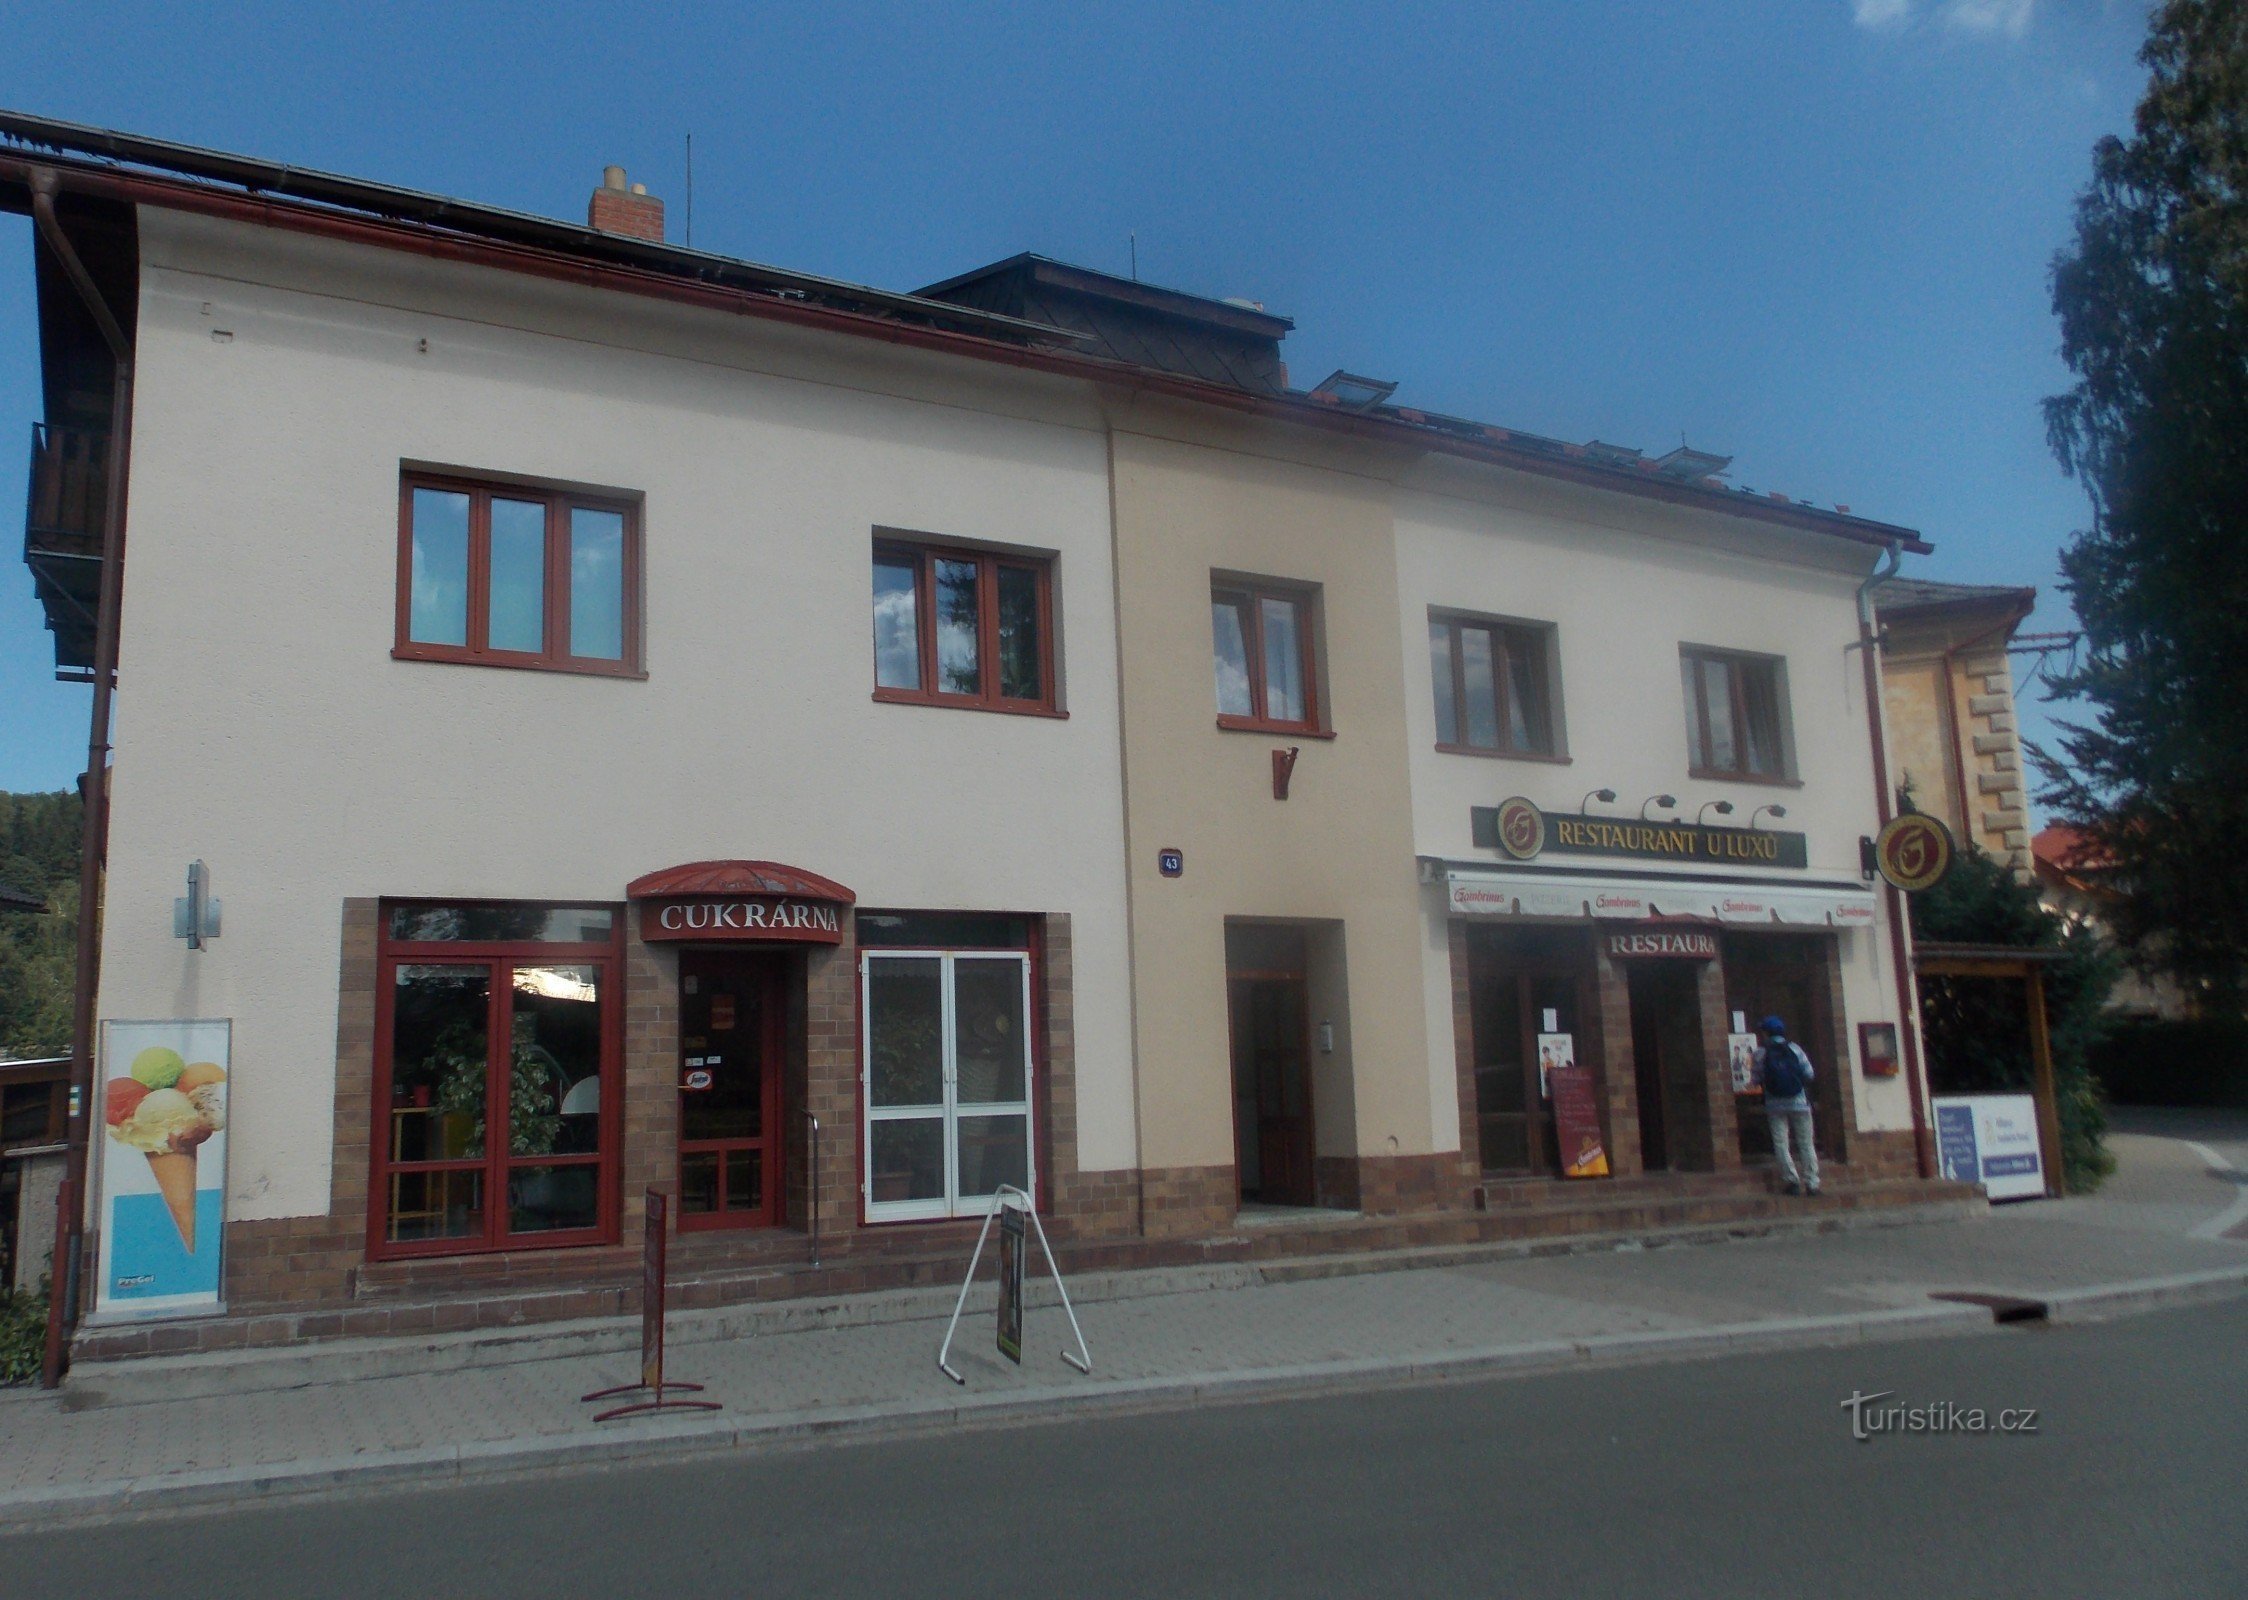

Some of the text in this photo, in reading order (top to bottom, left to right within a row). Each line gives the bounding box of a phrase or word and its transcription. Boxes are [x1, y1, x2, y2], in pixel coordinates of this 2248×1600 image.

[1557, 820, 1697, 854] RESTAURANT
[1707, 834, 1725, 855] U
[1166, 858, 1177, 869] 43
[1454, 887, 1504, 903] Gambrinus
[1596, 894, 1641, 909] Gambrinus
[660, 898, 839, 932] CUKRÁRNA
